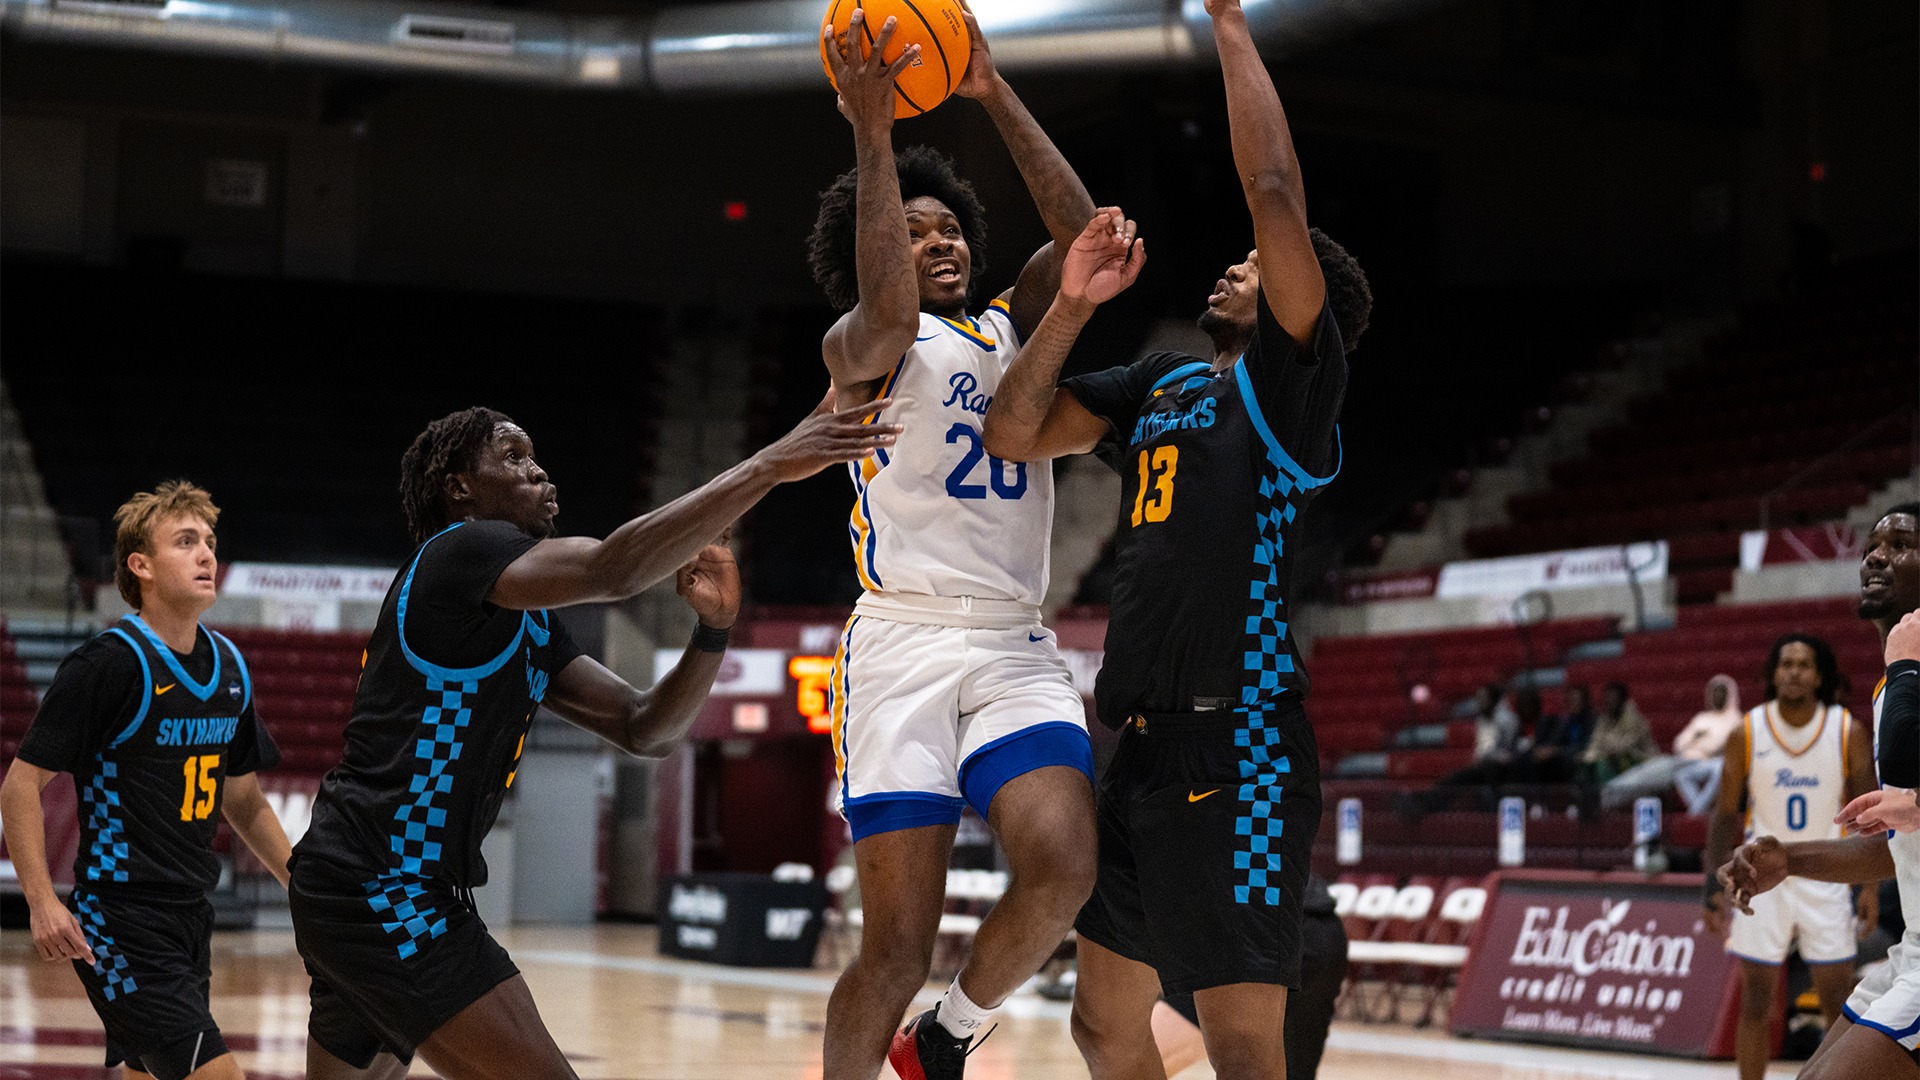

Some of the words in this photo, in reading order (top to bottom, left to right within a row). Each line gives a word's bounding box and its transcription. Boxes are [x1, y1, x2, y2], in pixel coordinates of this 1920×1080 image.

[942, 371, 993, 415] Ra
[945, 422, 1028, 500] 20
[1131, 444, 1179, 528] 13
[156, 716, 239, 746] SKYHAWK
[180, 754, 220, 821] 15
[1787, 793, 1807, 831] 0
[1500, 971, 1587, 1004] credit
[1597, 978, 1684, 1013] union
